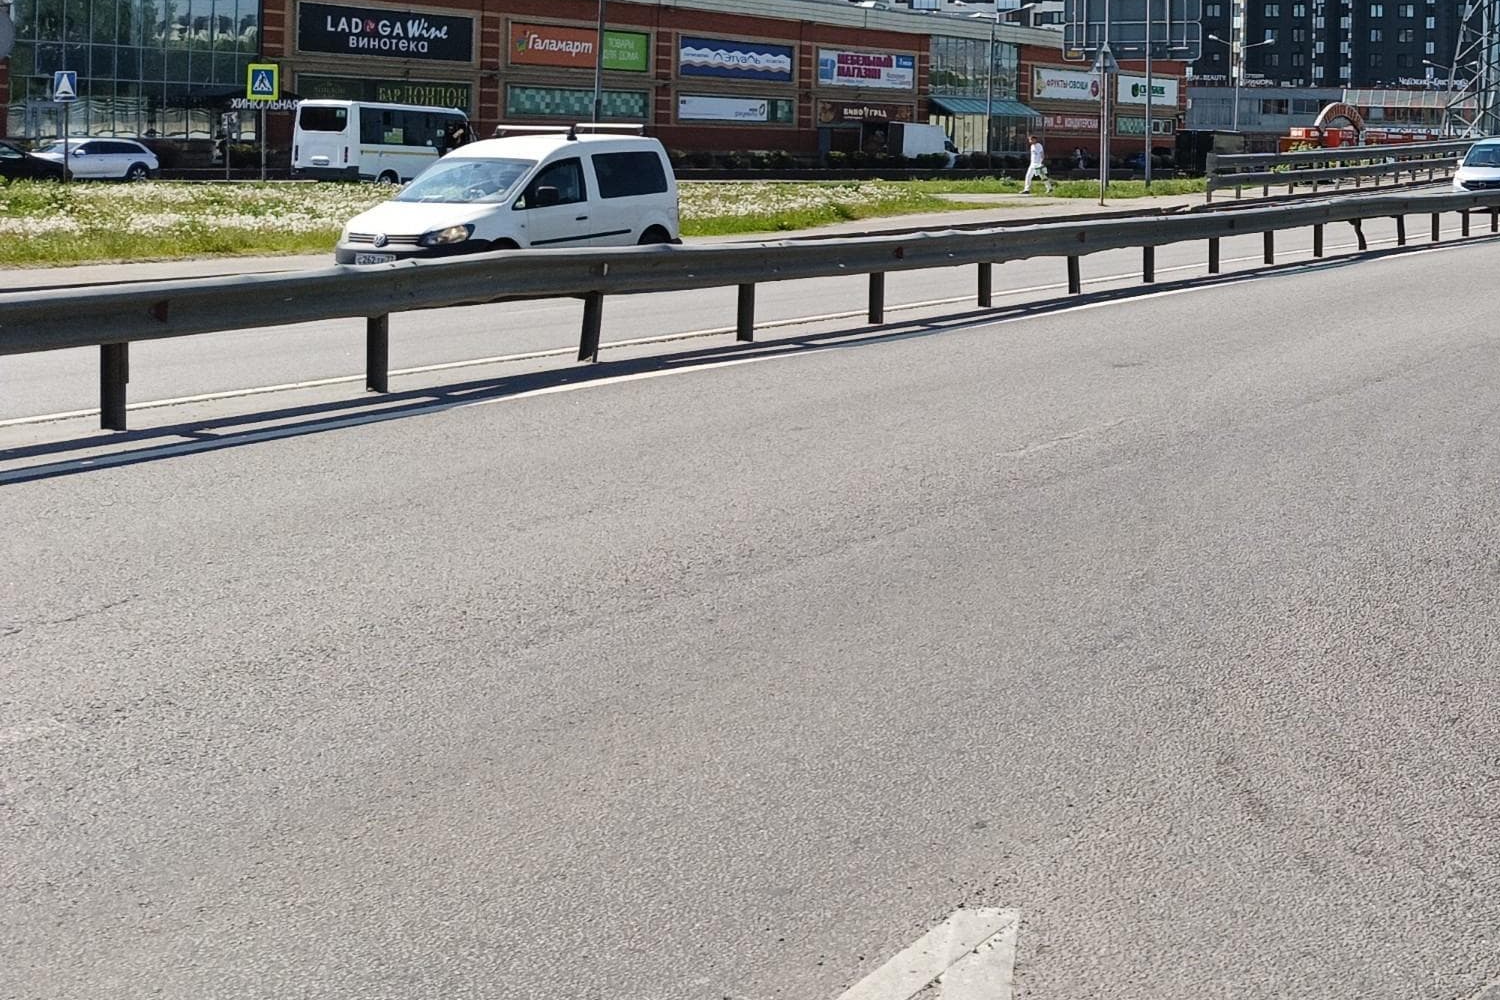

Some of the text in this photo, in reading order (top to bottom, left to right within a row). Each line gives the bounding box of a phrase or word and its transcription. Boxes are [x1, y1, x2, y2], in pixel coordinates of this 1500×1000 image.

[406, 18, 449, 39] Wine
[528, 34, 593, 56] Галамарт
[837, 53, 893, 68] МЕБЕЛЬНЫЙ
[837, 65, 882, 79] МАГАЗИН
[404, 85, 468, 108] ЛОНДОН
